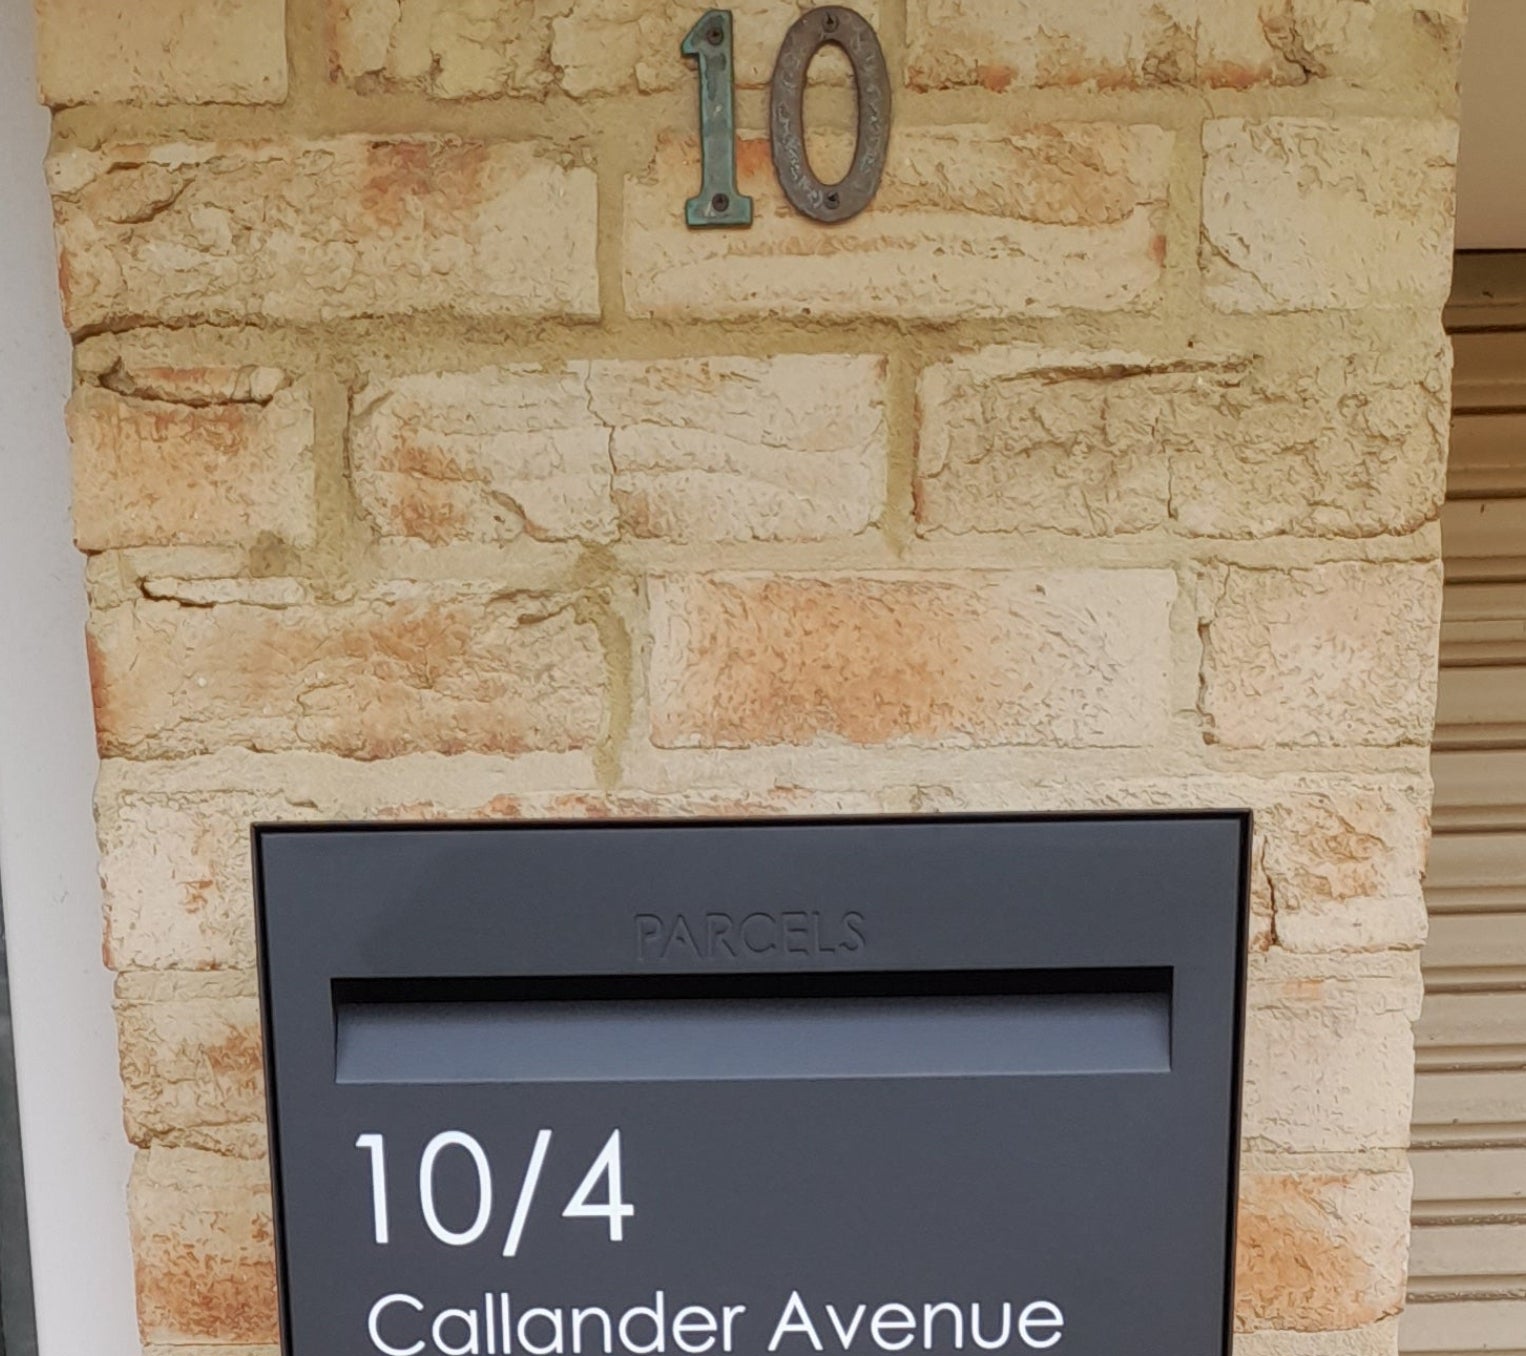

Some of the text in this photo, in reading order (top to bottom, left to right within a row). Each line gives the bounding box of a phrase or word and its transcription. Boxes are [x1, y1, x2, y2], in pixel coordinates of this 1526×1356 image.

[680, 5, 892, 228] 10
[634, 911, 866, 961] PARCELS
[355, 1128, 635, 1257] 10/4
[367, 1290, 1064, 1356] Callander Avenue
